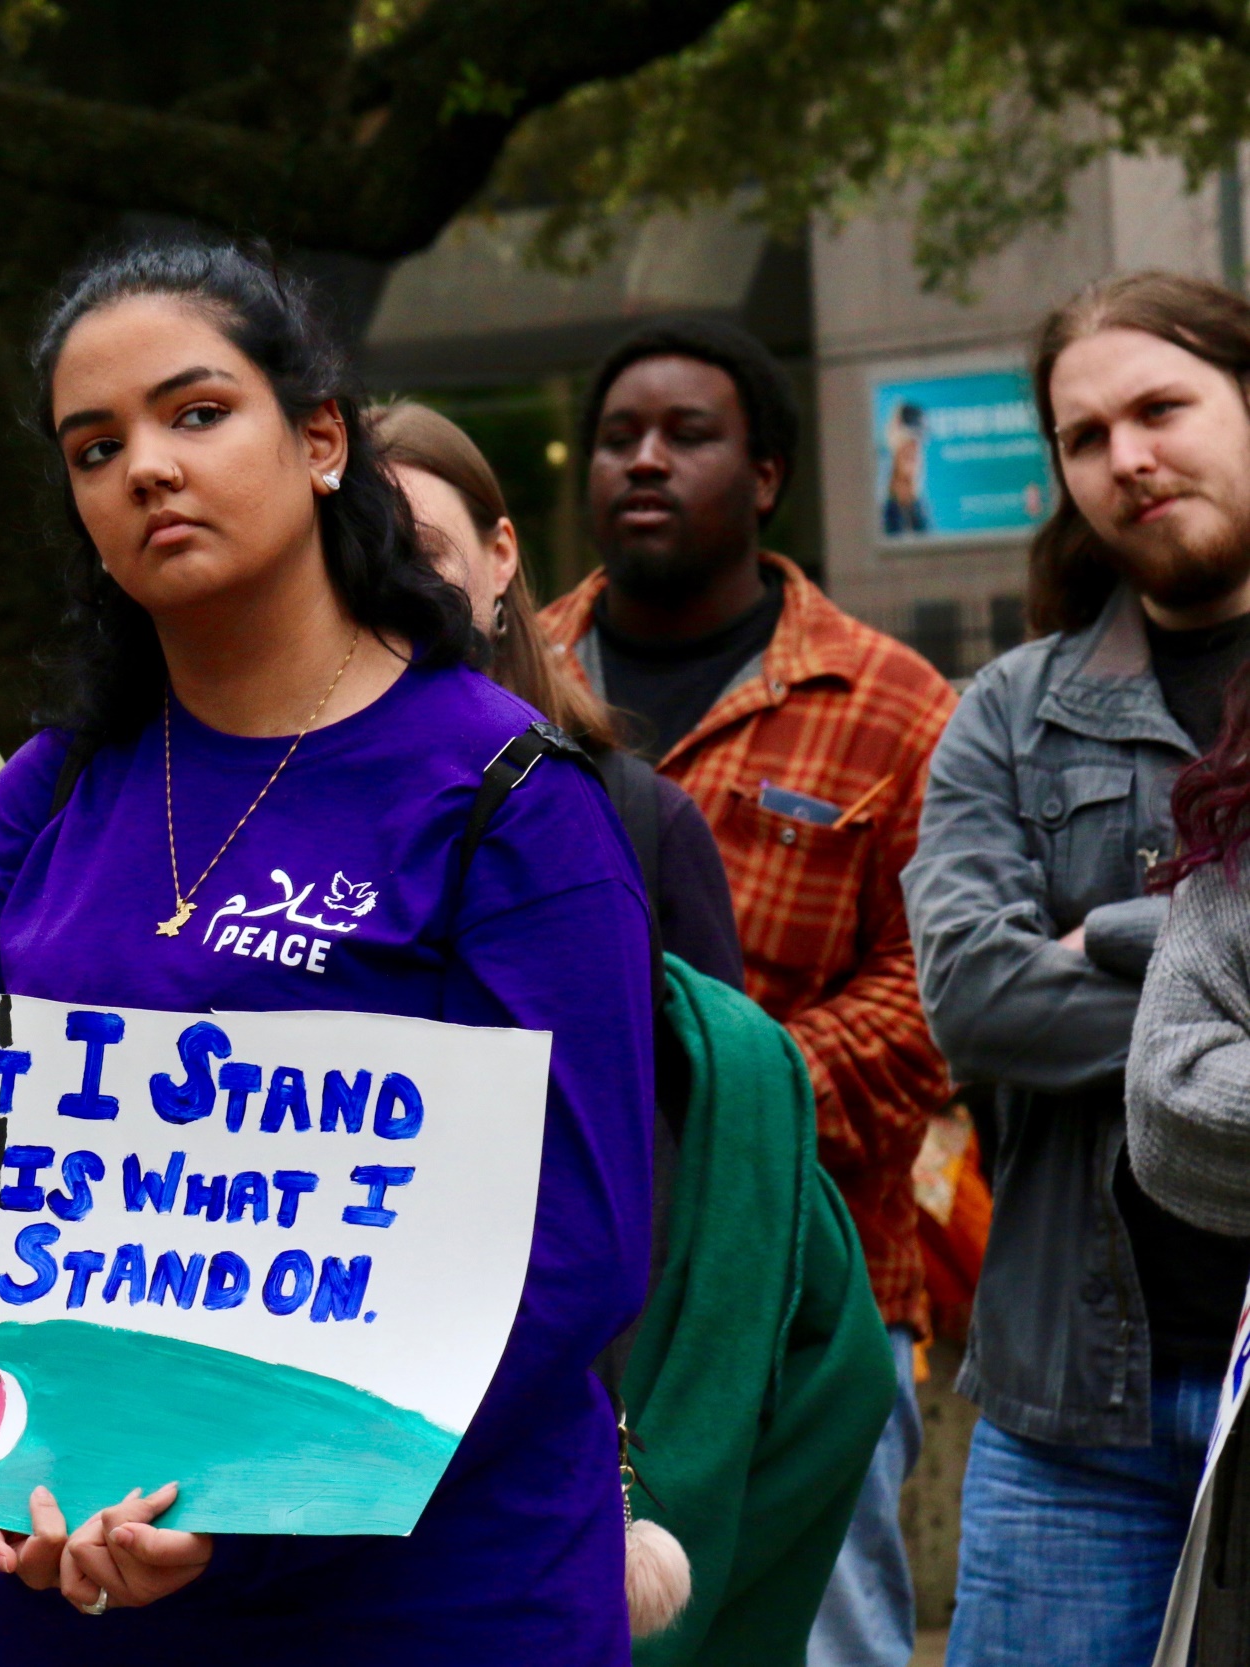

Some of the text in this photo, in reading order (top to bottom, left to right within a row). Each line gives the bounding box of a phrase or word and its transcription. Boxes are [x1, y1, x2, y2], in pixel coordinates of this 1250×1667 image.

[203, 868, 358, 945] سلام
[213, 925, 331, 974] PEACE
[57, 1011, 126, 1121] I
[149, 1021, 425, 1141] STAND
[122, 1151, 319, 1229] WHAT
[341, 1165, 416, 1228] I
[262, 1249, 378, 1324] ON.
